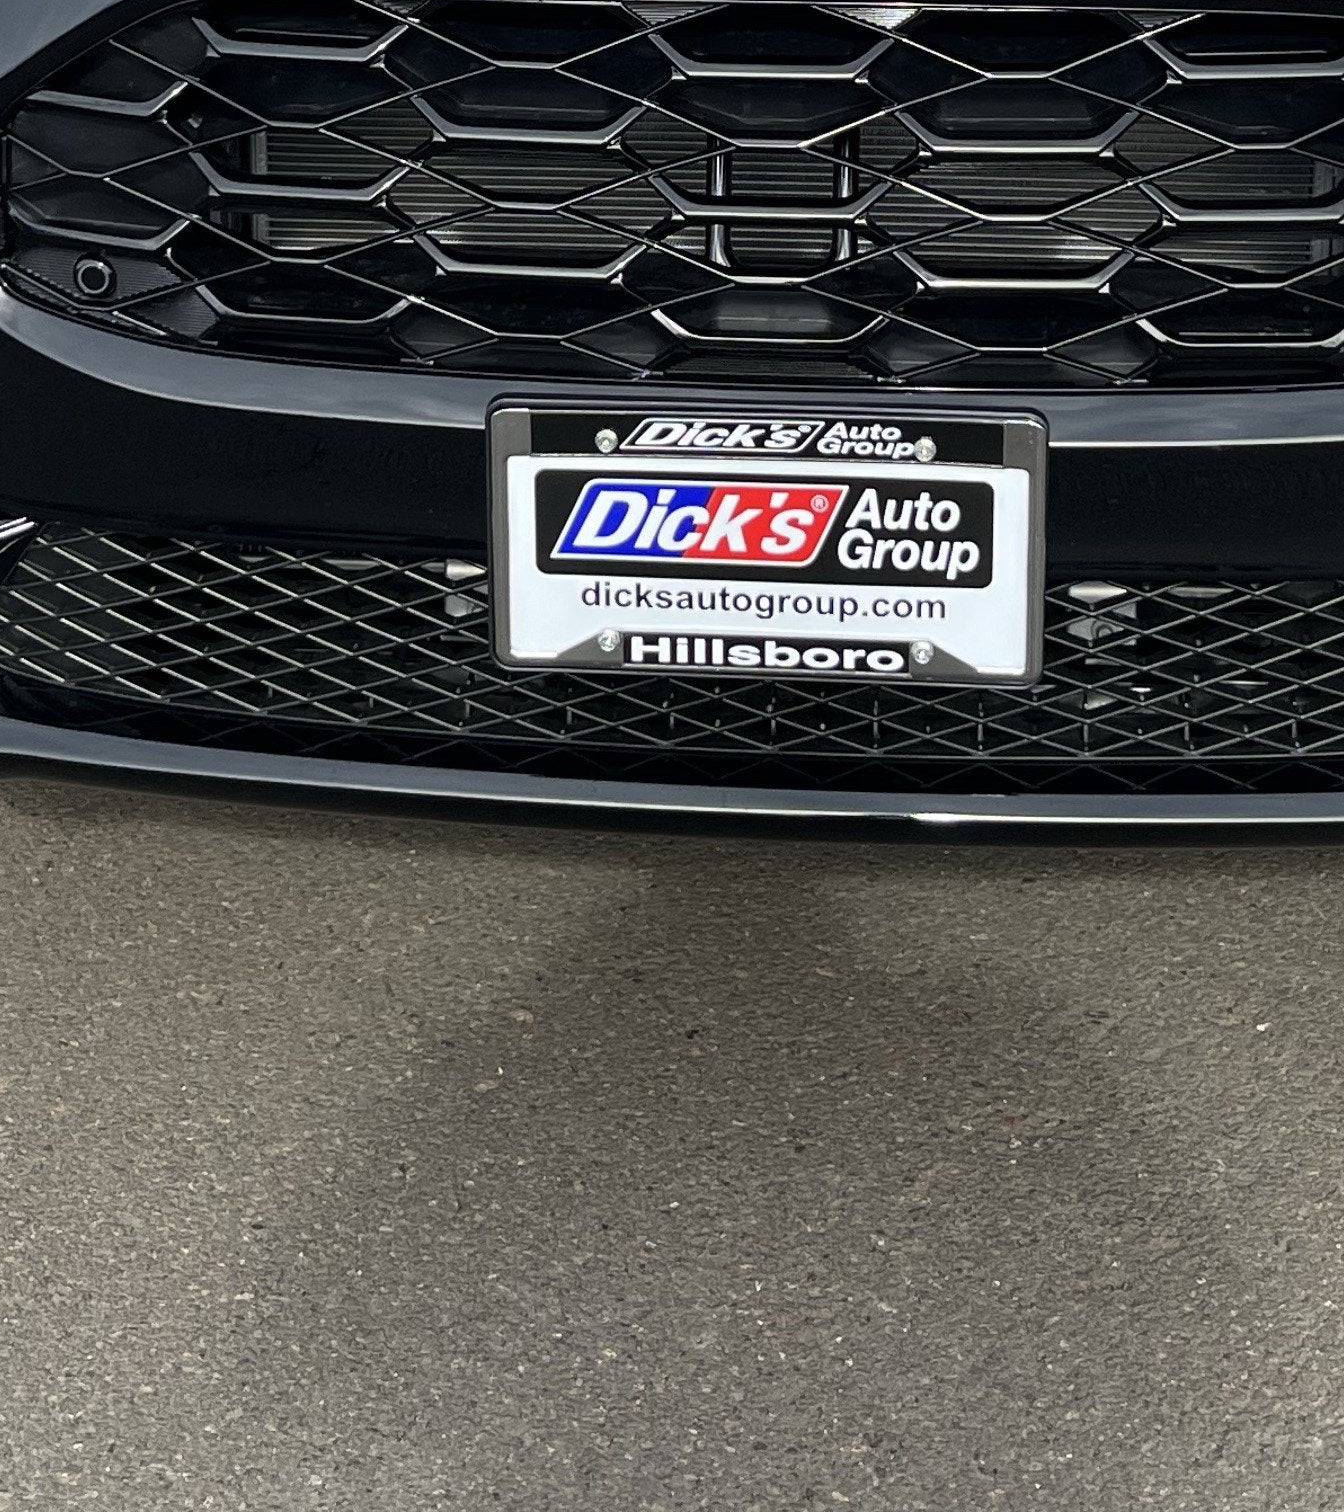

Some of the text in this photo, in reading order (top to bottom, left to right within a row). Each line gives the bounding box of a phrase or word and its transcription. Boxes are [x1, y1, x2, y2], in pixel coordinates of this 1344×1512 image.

[634, 421, 903, 449] Dick's Auto
[816, 437, 915, 460] Group
[572, 488, 961, 555] Dick's Auto
[836, 528, 980, 580] Group
[581, 581, 947, 622] dicksautogroup.com
[629, 635, 905, 671] Hillsboro
